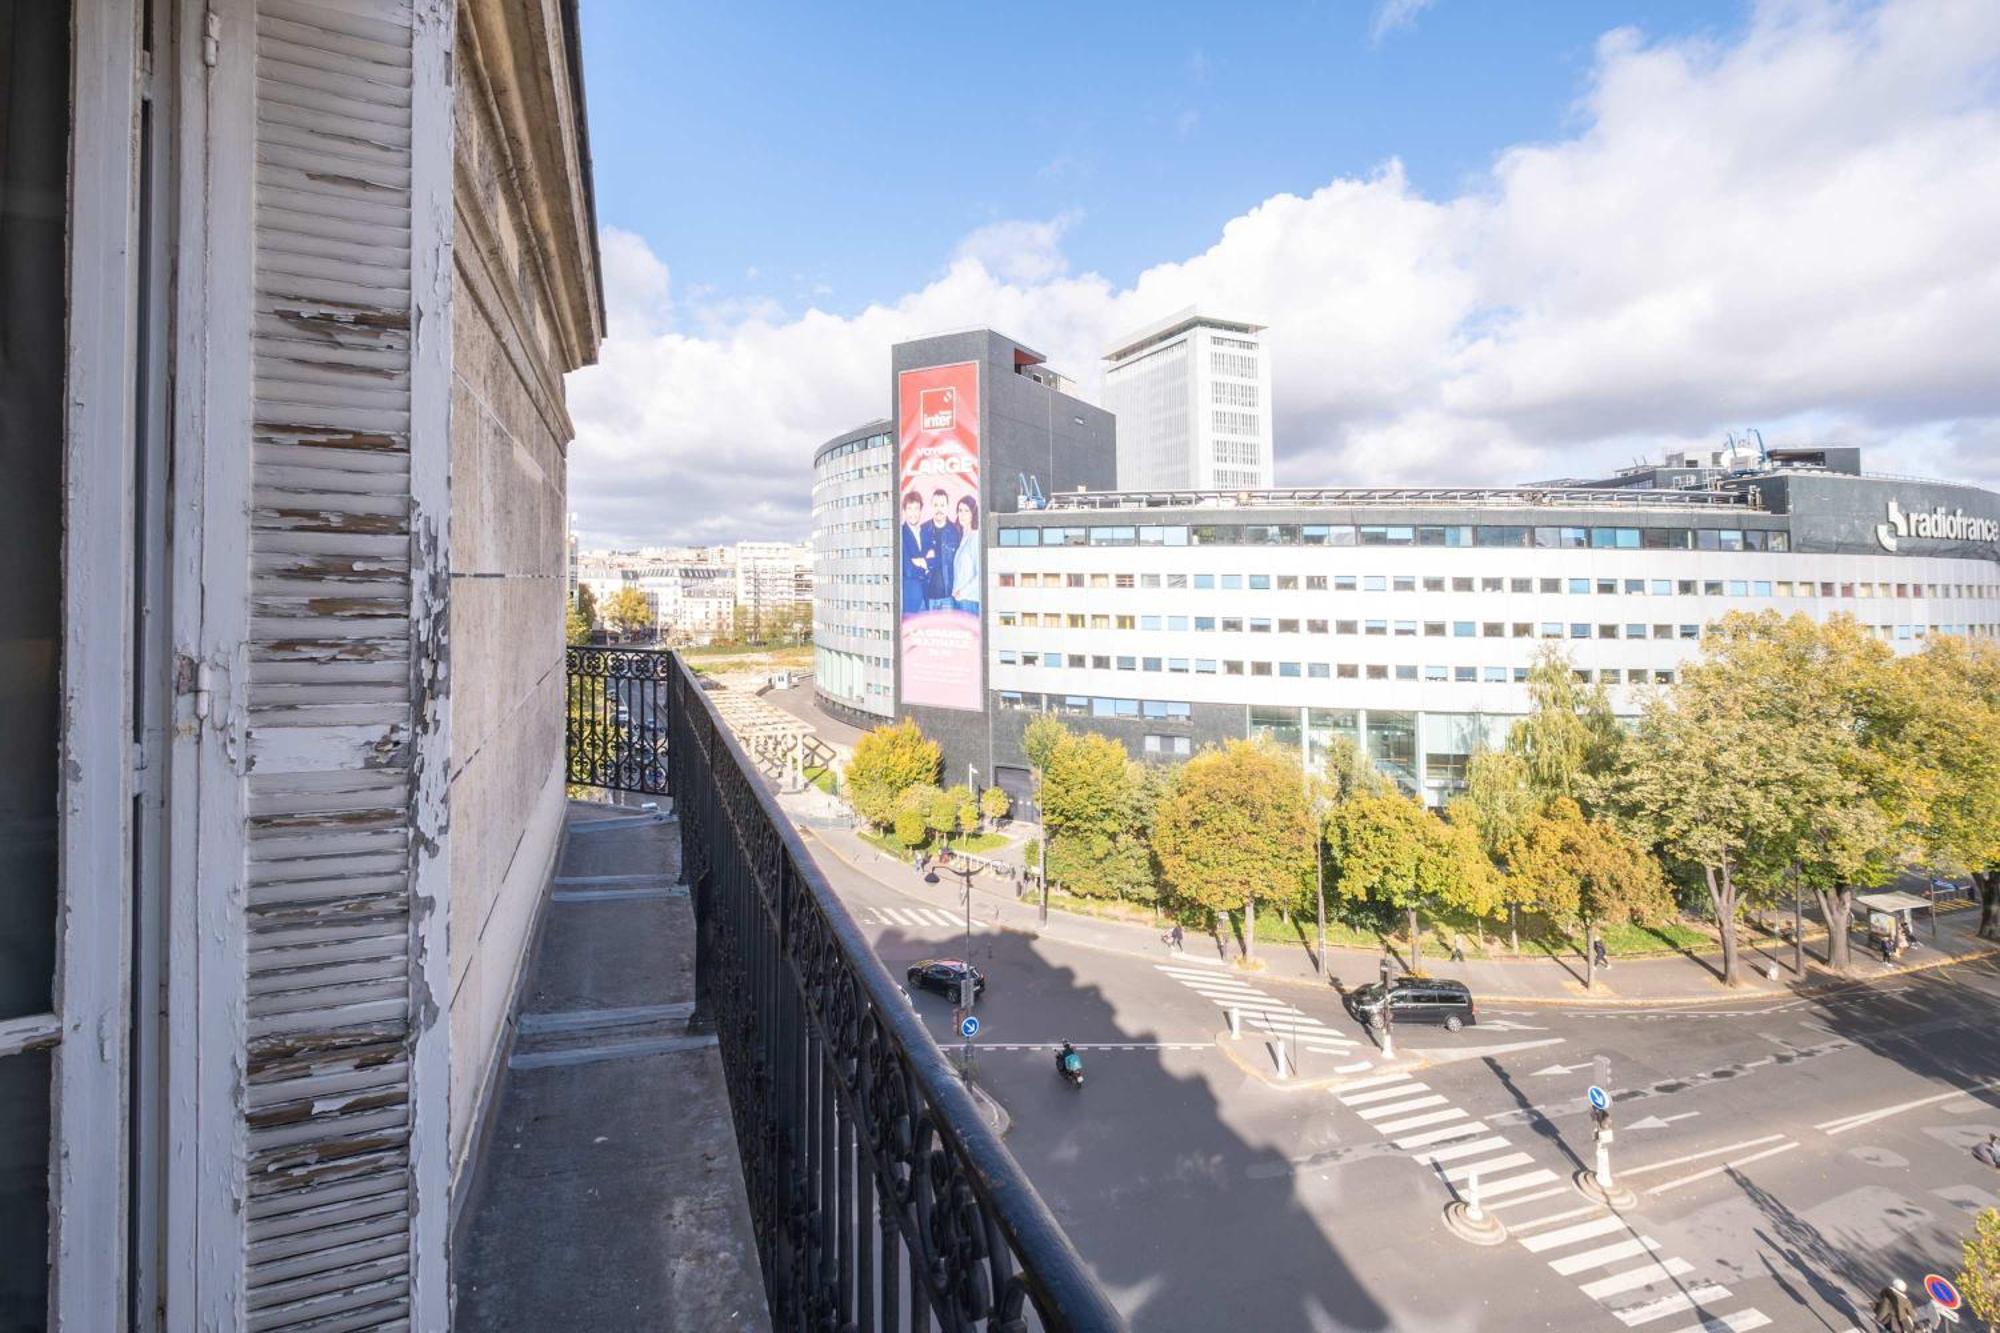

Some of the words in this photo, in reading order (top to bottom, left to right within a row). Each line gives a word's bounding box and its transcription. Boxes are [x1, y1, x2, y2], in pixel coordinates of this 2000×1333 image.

[924, 413, 952, 428] inter
[906, 456, 973, 475] LARGE
[1908, 506, 1999, 542] radiofrance
